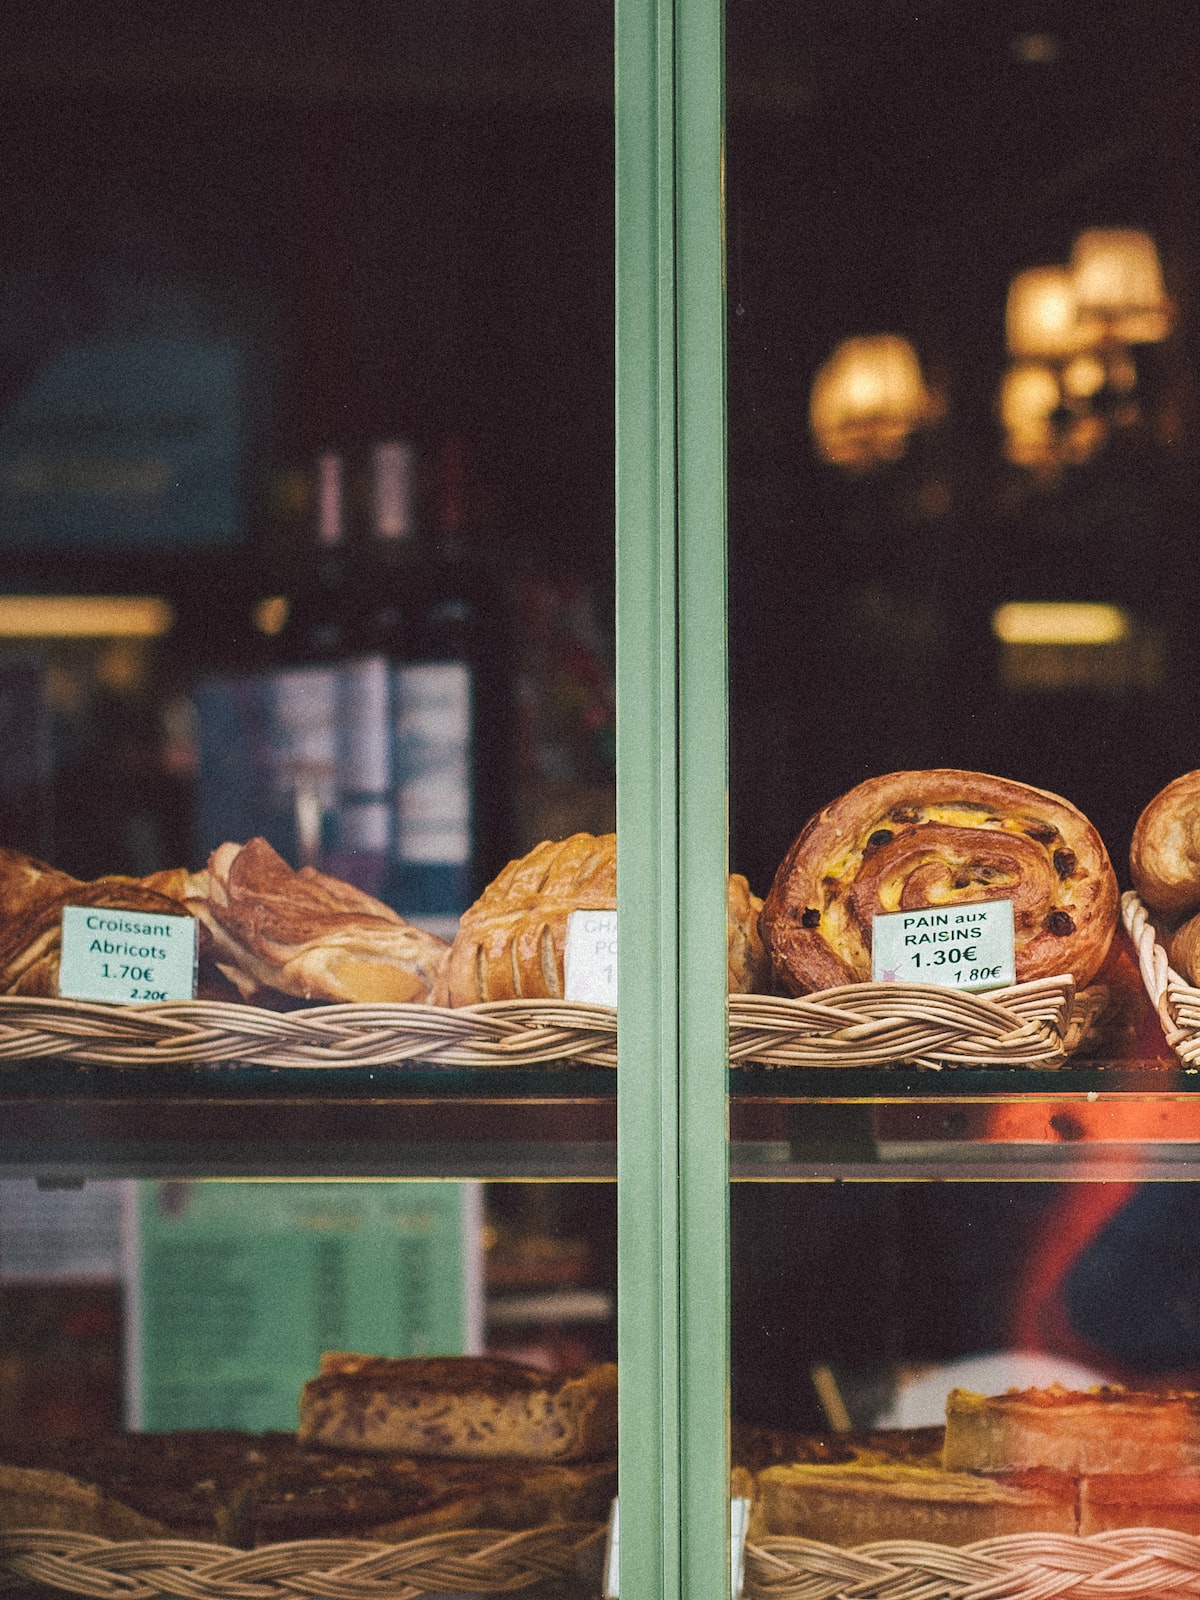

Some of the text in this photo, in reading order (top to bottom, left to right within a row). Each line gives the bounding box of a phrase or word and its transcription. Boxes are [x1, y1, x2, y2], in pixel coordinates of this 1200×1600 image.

[86, 915, 172, 937] Croissant
[903, 912, 988, 930] PAIN aux
[904, 926, 983, 946] RAISINS
[89, 939, 167, 960] Abricots
[911, 946, 978, 968] 1.30€
[101, 963, 155, 982] 1.70€
[954, 965, 1003, 984] 1.80€
[130, 988, 169, 1001] 2.20€
